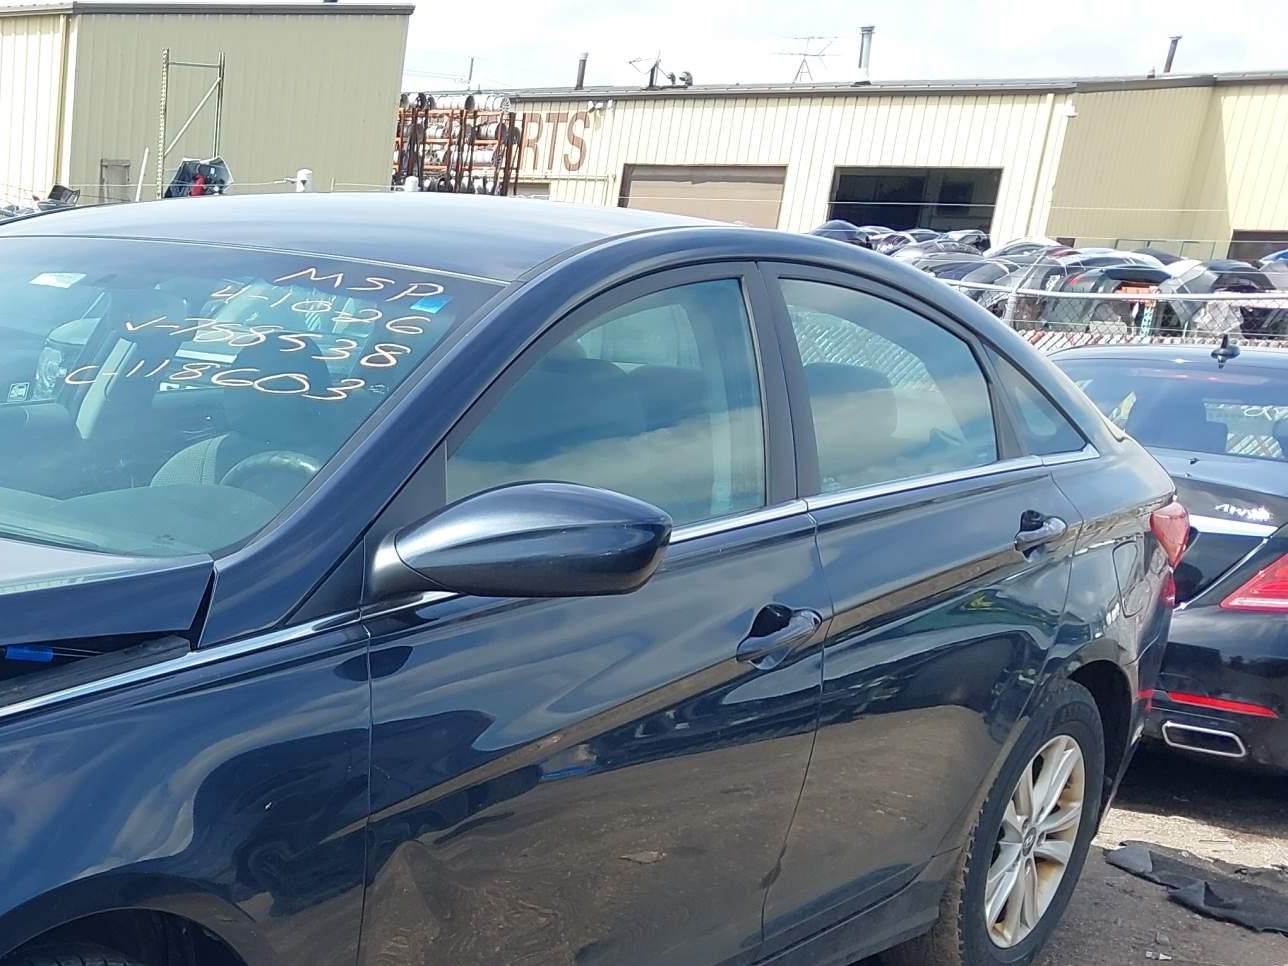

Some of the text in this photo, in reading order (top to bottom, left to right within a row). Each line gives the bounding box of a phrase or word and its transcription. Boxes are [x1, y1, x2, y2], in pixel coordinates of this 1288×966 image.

[520, 111, 590, 171] RTS
[274, 267, 444, 302] MSP
[64, 361, 366, 400] C-118603
